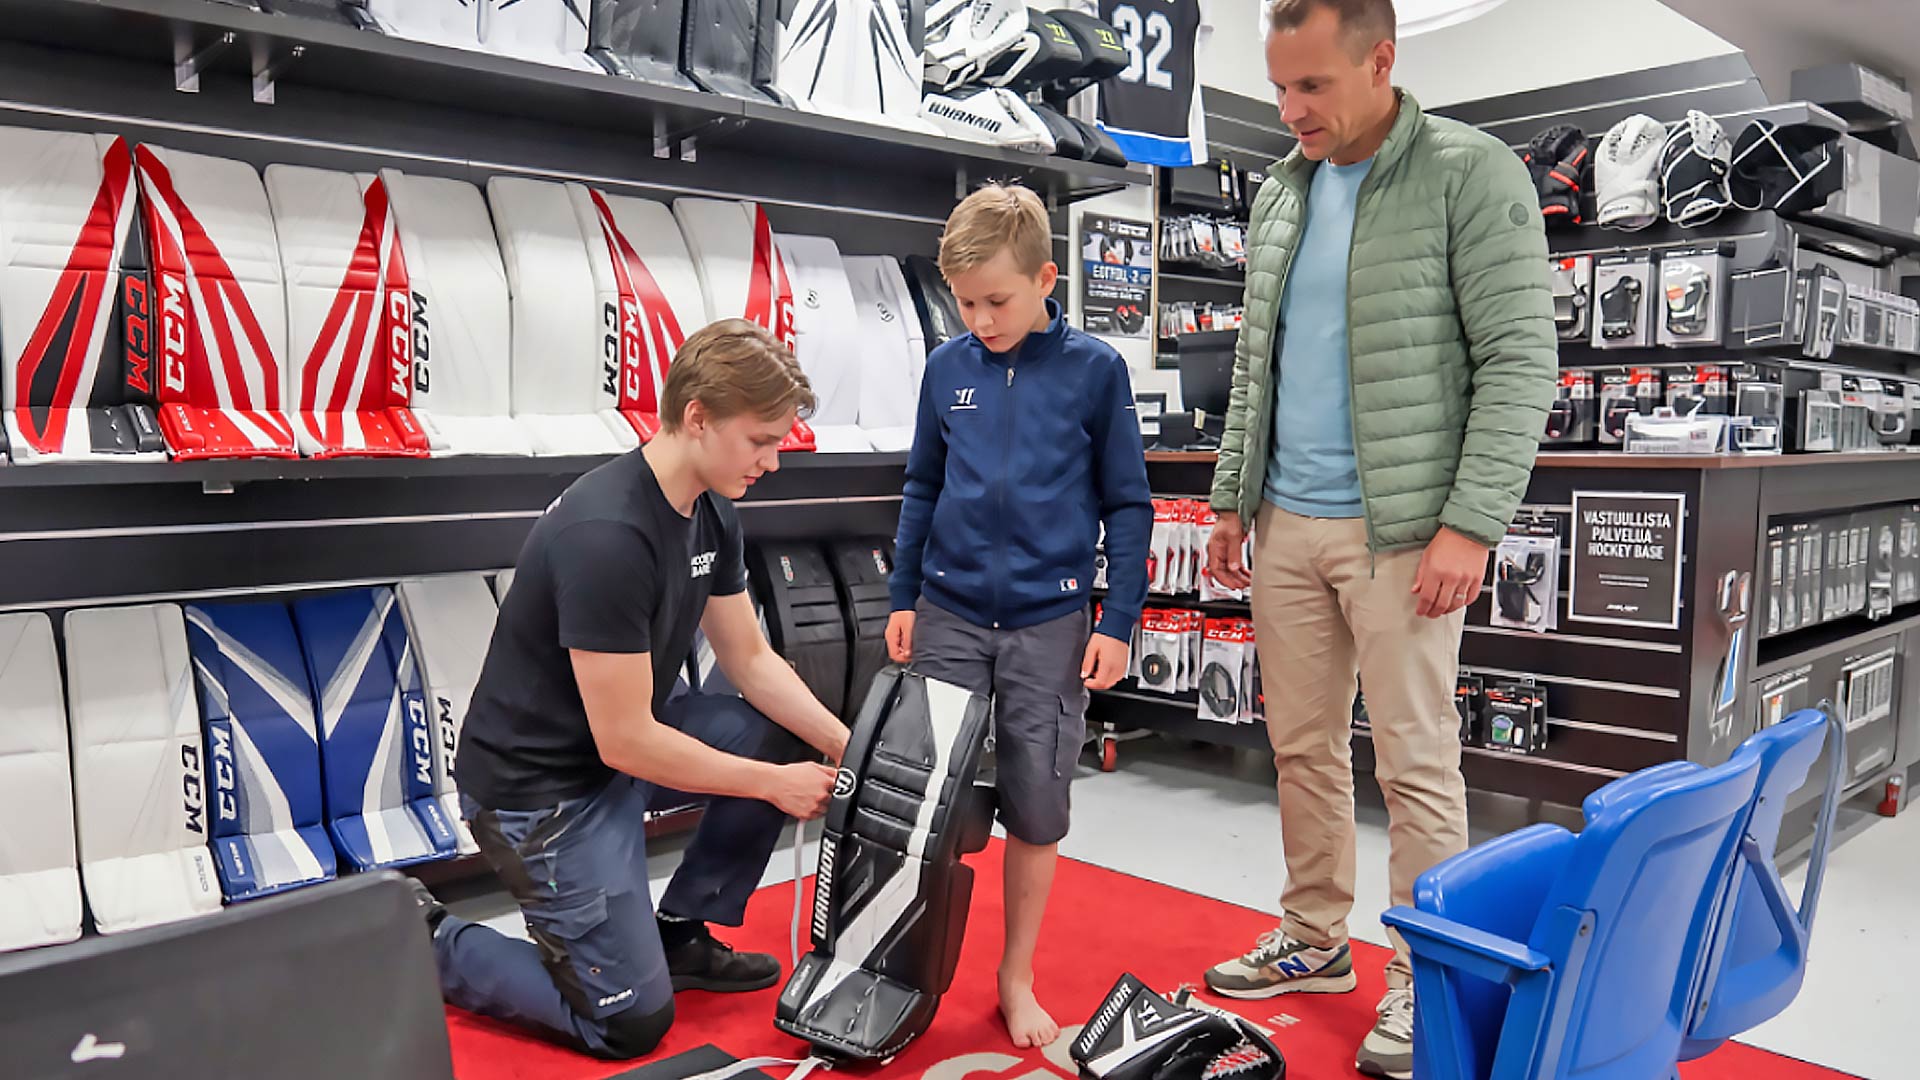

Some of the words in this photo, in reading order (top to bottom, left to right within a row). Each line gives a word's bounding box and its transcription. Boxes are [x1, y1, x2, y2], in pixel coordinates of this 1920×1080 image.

[1111, 5, 1172, 90] 32
[125, 275, 149, 393] CCM
[163, 274, 185, 393] CCM
[390, 291, 409, 397] CCM
[412, 291, 430, 393] CCM
[603, 302, 618, 396] CCM
[624, 300, 639, 401] CCM
[783, 301, 797, 356] CC
[1583, 510, 1671, 528] VASTUULLISTA
[1588, 542, 1631, 558] HOCKEY
[1634, 545, 1664, 560] BASE
[1592, 526, 1652, 543] PALVELUA
[1145, 620, 1178, 630] CCM
[1208, 629, 1242, 640] CCM
[211, 726, 237, 820] CCM
[408, 699, 432, 784] CCM
[181, 744, 203, 834] CCM
[813, 837, 836, 940] WARRIOR
[1080, 983, 1132, 1054] WARRIOR
